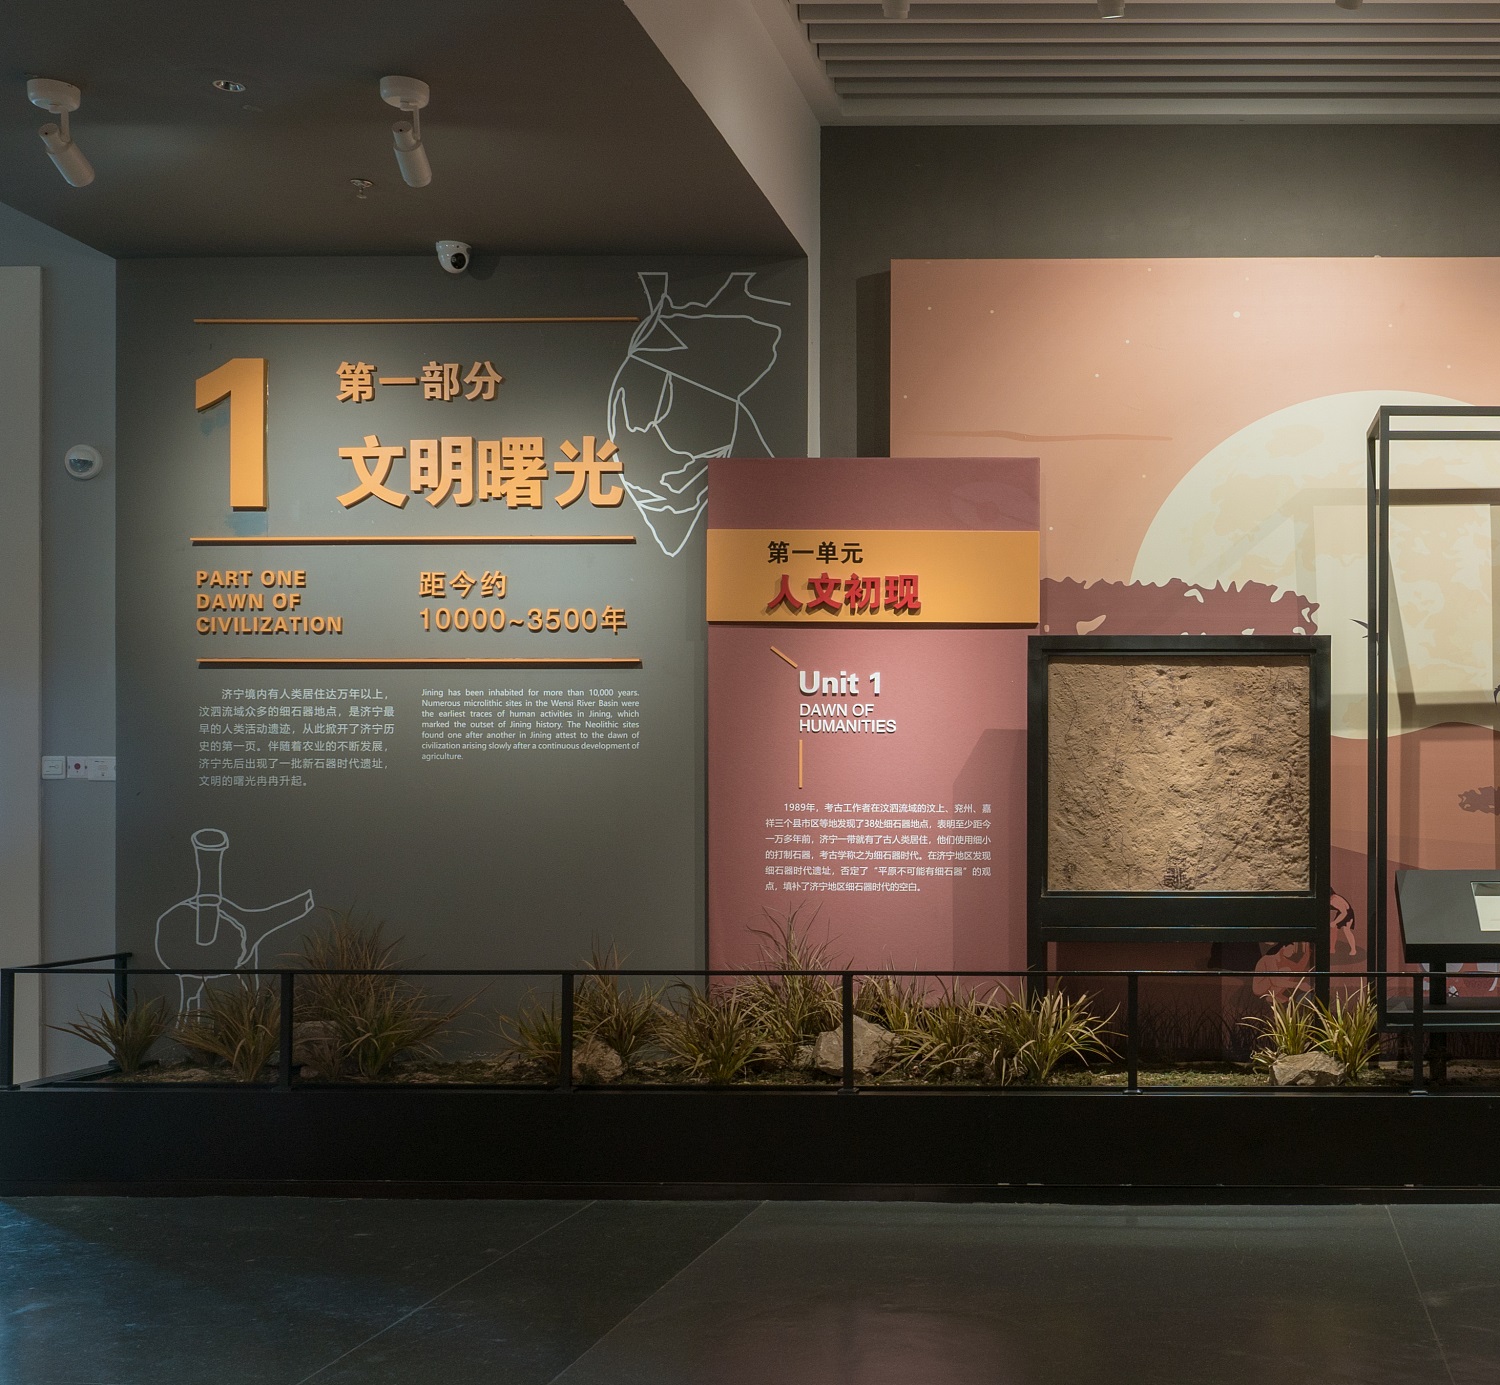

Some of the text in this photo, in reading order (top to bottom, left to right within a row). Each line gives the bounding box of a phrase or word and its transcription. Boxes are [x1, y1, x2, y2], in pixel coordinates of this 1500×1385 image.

[335, 360, 503, 402] 第一部分
[196, 358, 267, 511] 1
[336, 434, 626, 509] 文明曙光
[766, 540, 864, 564] 第一单元
[196, 570, 306, 587] PART ONE
[419, 571, 508, 598] 距今约
[766, 572, 922, 610] 人文初现
[196, 593, 302, 610] DAWN OF
[196, 616, 343, 634] CIVILIZATION
[419, 605, 628, 634] 10000~3500年
[799, 670, 881, 694] Unit 1
[221, 688, 389, 700] 济宁境内有人类居住达万年以上，
[422, 688, 444, 699] Jining
[448, 688, 462, 697] has
[466, 688, 485, 697] been
[489, 688, 524, 697] inhabited
[528, 688, 540, 697] for
[567, 688, 585, 697] than
[589, 688, 614, 698] 10,000
[618, 690, 640, 699] years.
[422, 699, 461, 707] Numerous
[464, 698, 503, 707] microlithic
[506, 699, 523, 707] sites
[526, 699, 533, 707] in
[536, 699, 549, 707] the
[551, 699, 574, 707] Wensi
[577, 699, 596, 707] River
[599, 699, 619, 707] Basin
[198, 705, 395, 717] 汶泗流域众多的细石器地点，是济宁最
[422, 709, 640, 720] the earliest traces of human activities in Jining, which
[799, 703, 875, 717] DAWN OF
[199, 723, 395, 735] 早的人类活动遗迹，从此掀开了济宁历
[422, 720, 640, 731] marked the outset of Jining history. The Neolithic sites
[799, 719, 897, 733] HUMANITIES
[422, 730, 445, 739] found
[465, 730, 484, 739] after
[487, 730, 516, 739] another
[520, 730, 527, 739] in
[530, 730, 552, 741] Jining
[556, 731, 577, 739] attest
[580, 731, 589, 739] to
[592, 731, 605, 739] the
[608, 730, 629, 739] dawn
[632, 730, 640, 739] of
[199, 740, 389, 752] 史的第一页。伴随着农业的不断发展，
[422, 741, 641, 752] civilization arising slowly after a continuous development of
[198, 758, 389, 769] 济宁先后出现了一批新石器时代遗址，
[422, 752, 464, 763] agriculture.
[199, 775, 308, 787] 文明的曙光冉冉升起。
